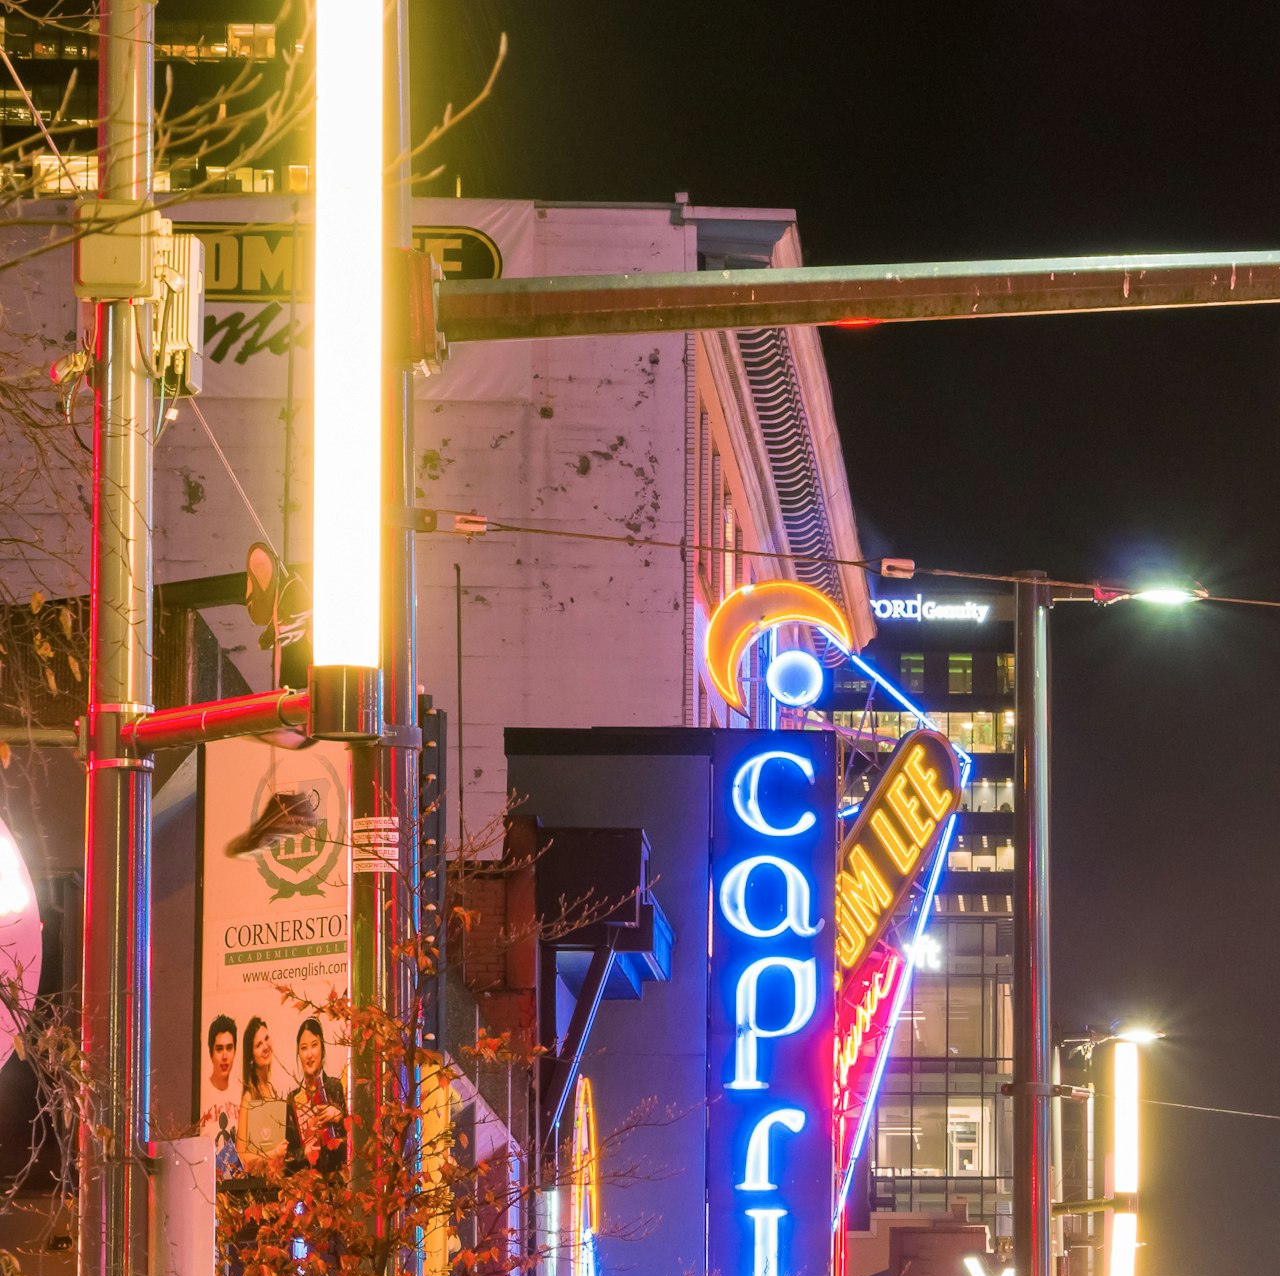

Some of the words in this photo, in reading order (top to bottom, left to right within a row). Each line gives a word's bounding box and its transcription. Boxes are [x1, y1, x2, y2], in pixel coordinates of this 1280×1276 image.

[922, 601, 989, 622] Genuity
[870, 744, 952, 876] LEE
[229, 947, 297, 963] ACADEMIC
